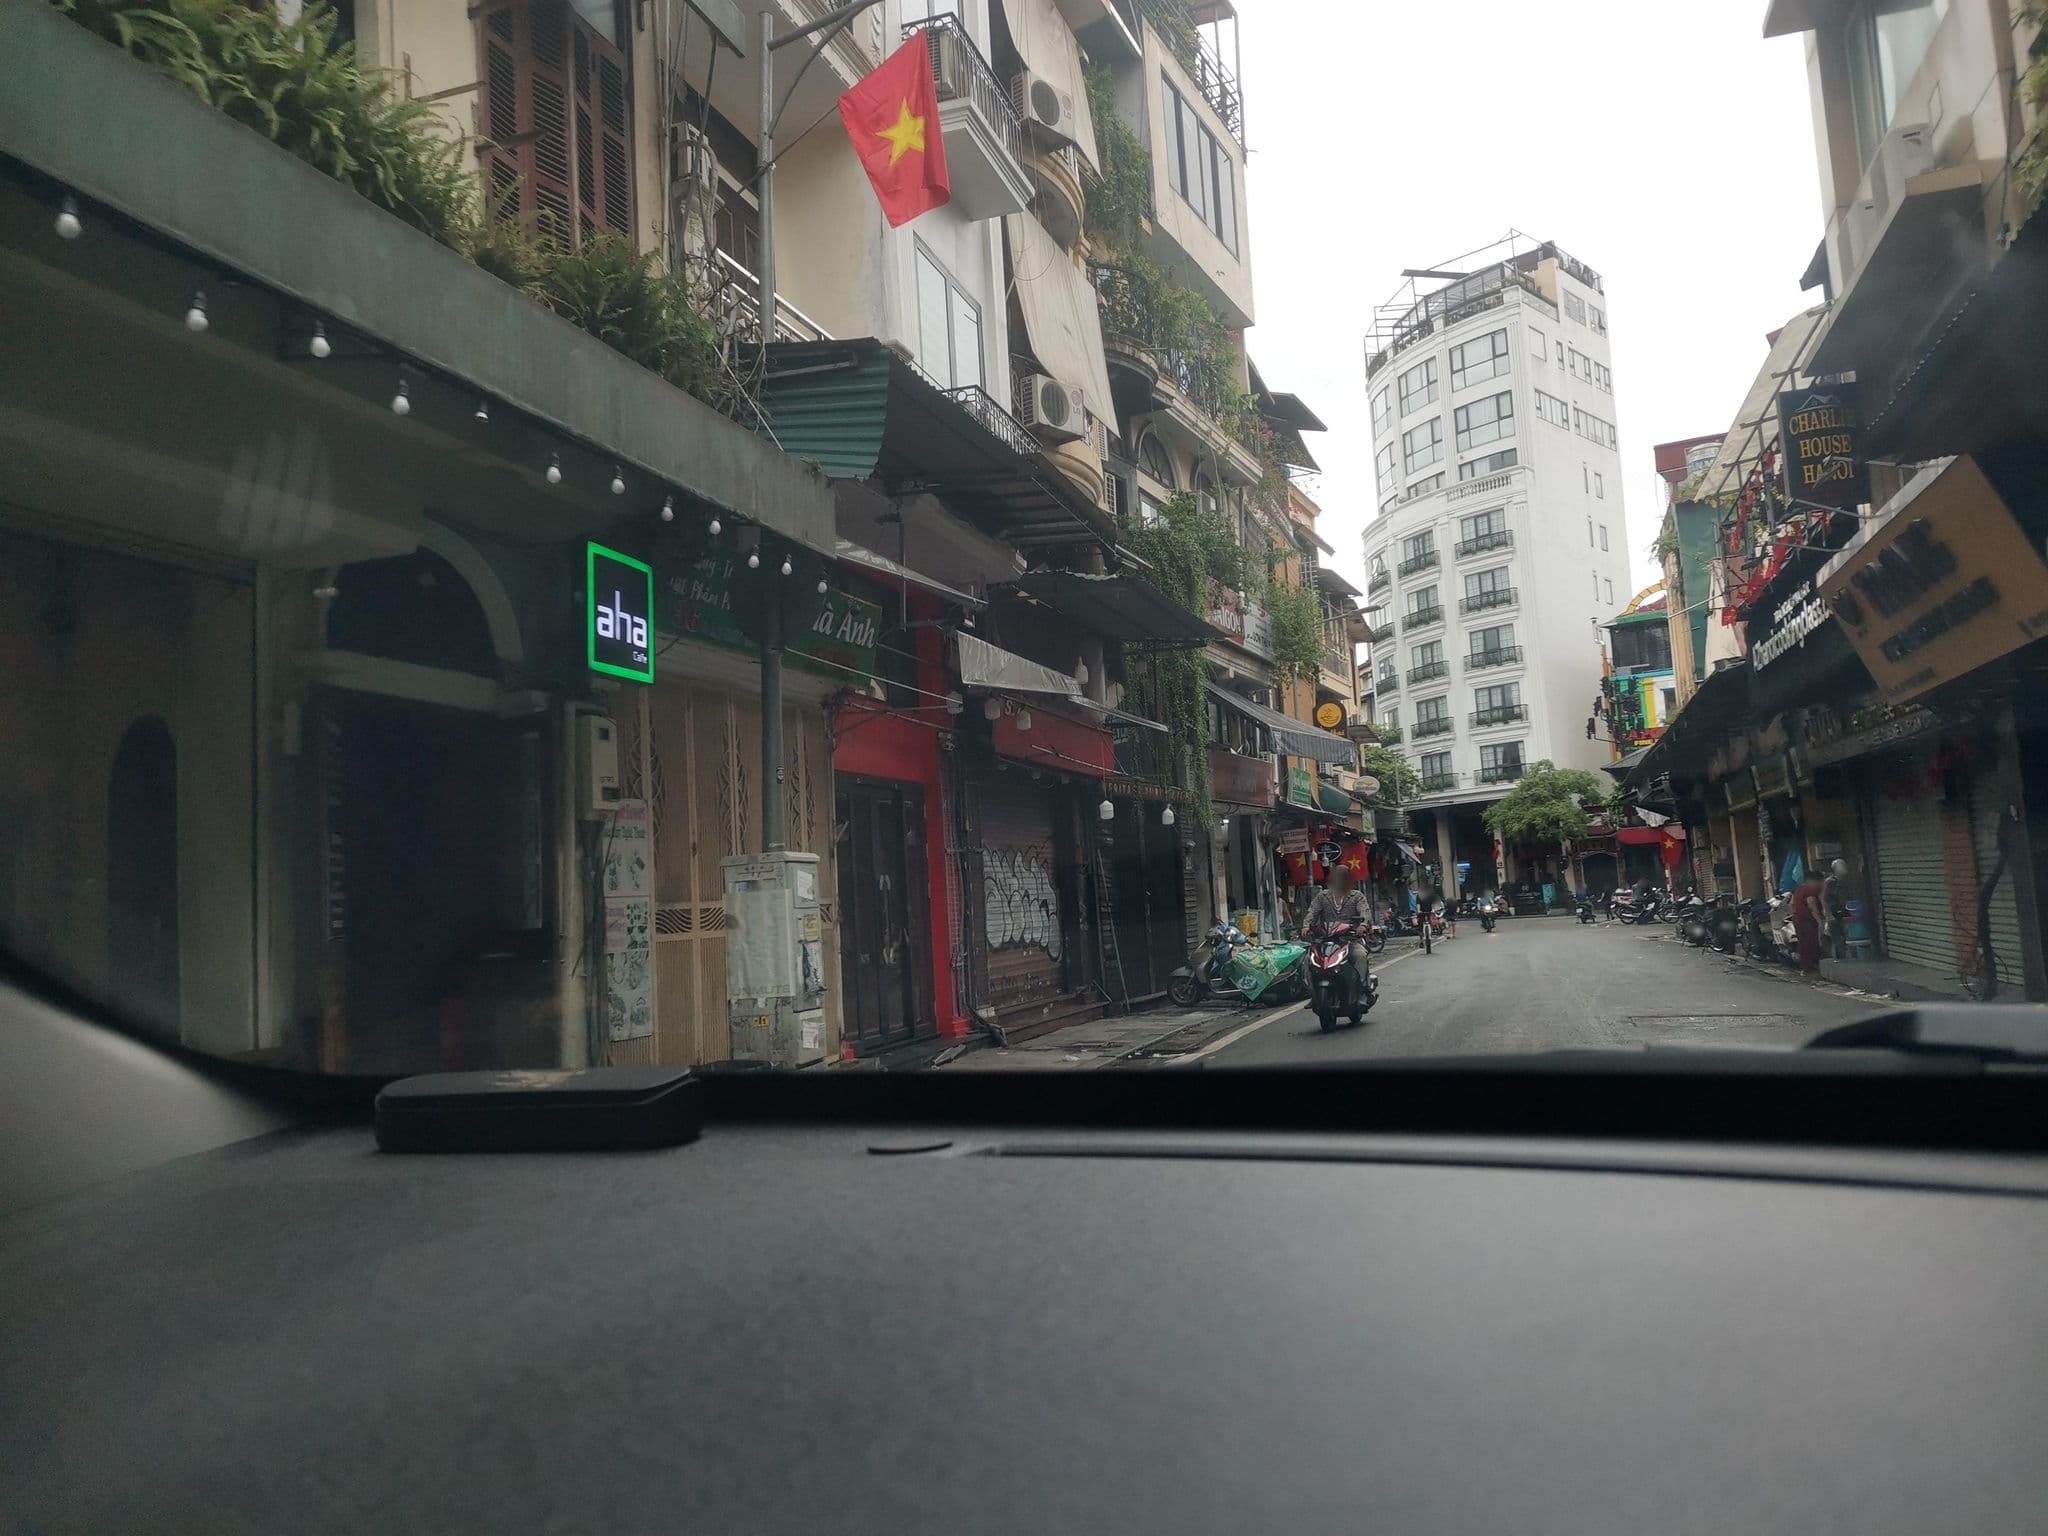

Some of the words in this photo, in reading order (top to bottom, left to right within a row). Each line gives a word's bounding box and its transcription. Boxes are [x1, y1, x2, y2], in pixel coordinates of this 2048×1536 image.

[1800, 434, 1852, 459] HOUSE
[1802, 461, 1855, 485] HAOI
[597, 590, 648, 649] aha
